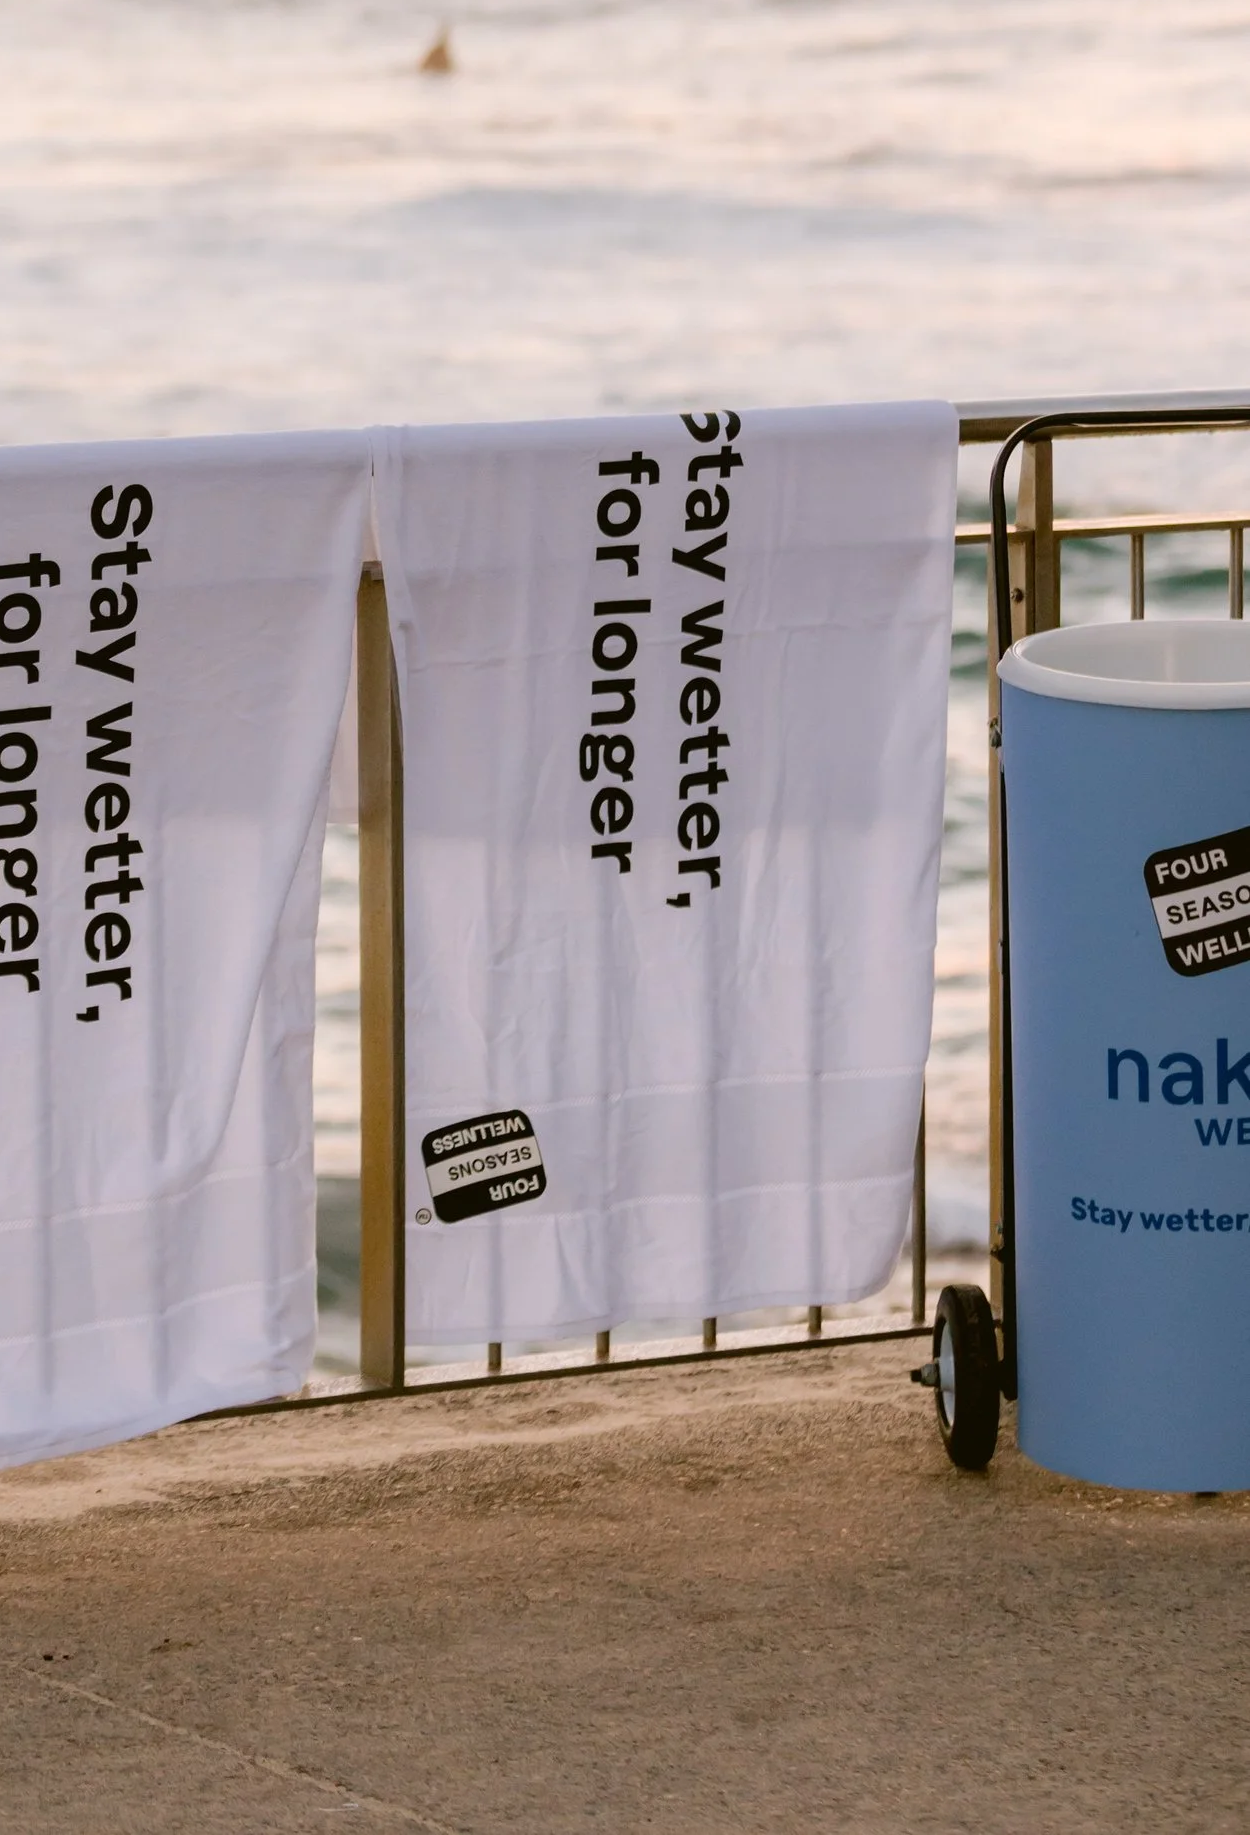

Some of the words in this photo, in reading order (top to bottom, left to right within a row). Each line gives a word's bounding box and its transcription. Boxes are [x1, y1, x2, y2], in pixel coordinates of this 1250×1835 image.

[595, 450, 660, 578] for
[75, 483, 154, 684] Stay
[579, 598, 652, 874] longer
[666, 599, 731, 909] wetter,
[76, 701, 145, 1023] wetter,
[1154, 848, 1229, 885] FOUR
[1166, 884, 1250, 925] SEASO
[1175, 926, 1250, 967] WELL
[1107, 1037, 1250, 1105] nak
[431, 1116, 526, 1155] WELLNESS
[448, 1146, 532, 1181] SEASONS
[488, 1174, 539, 1202] FOUR
[1070, 1196, 1133, 1233] Stay
[1139, 1207, 1250, 1233] wetter
